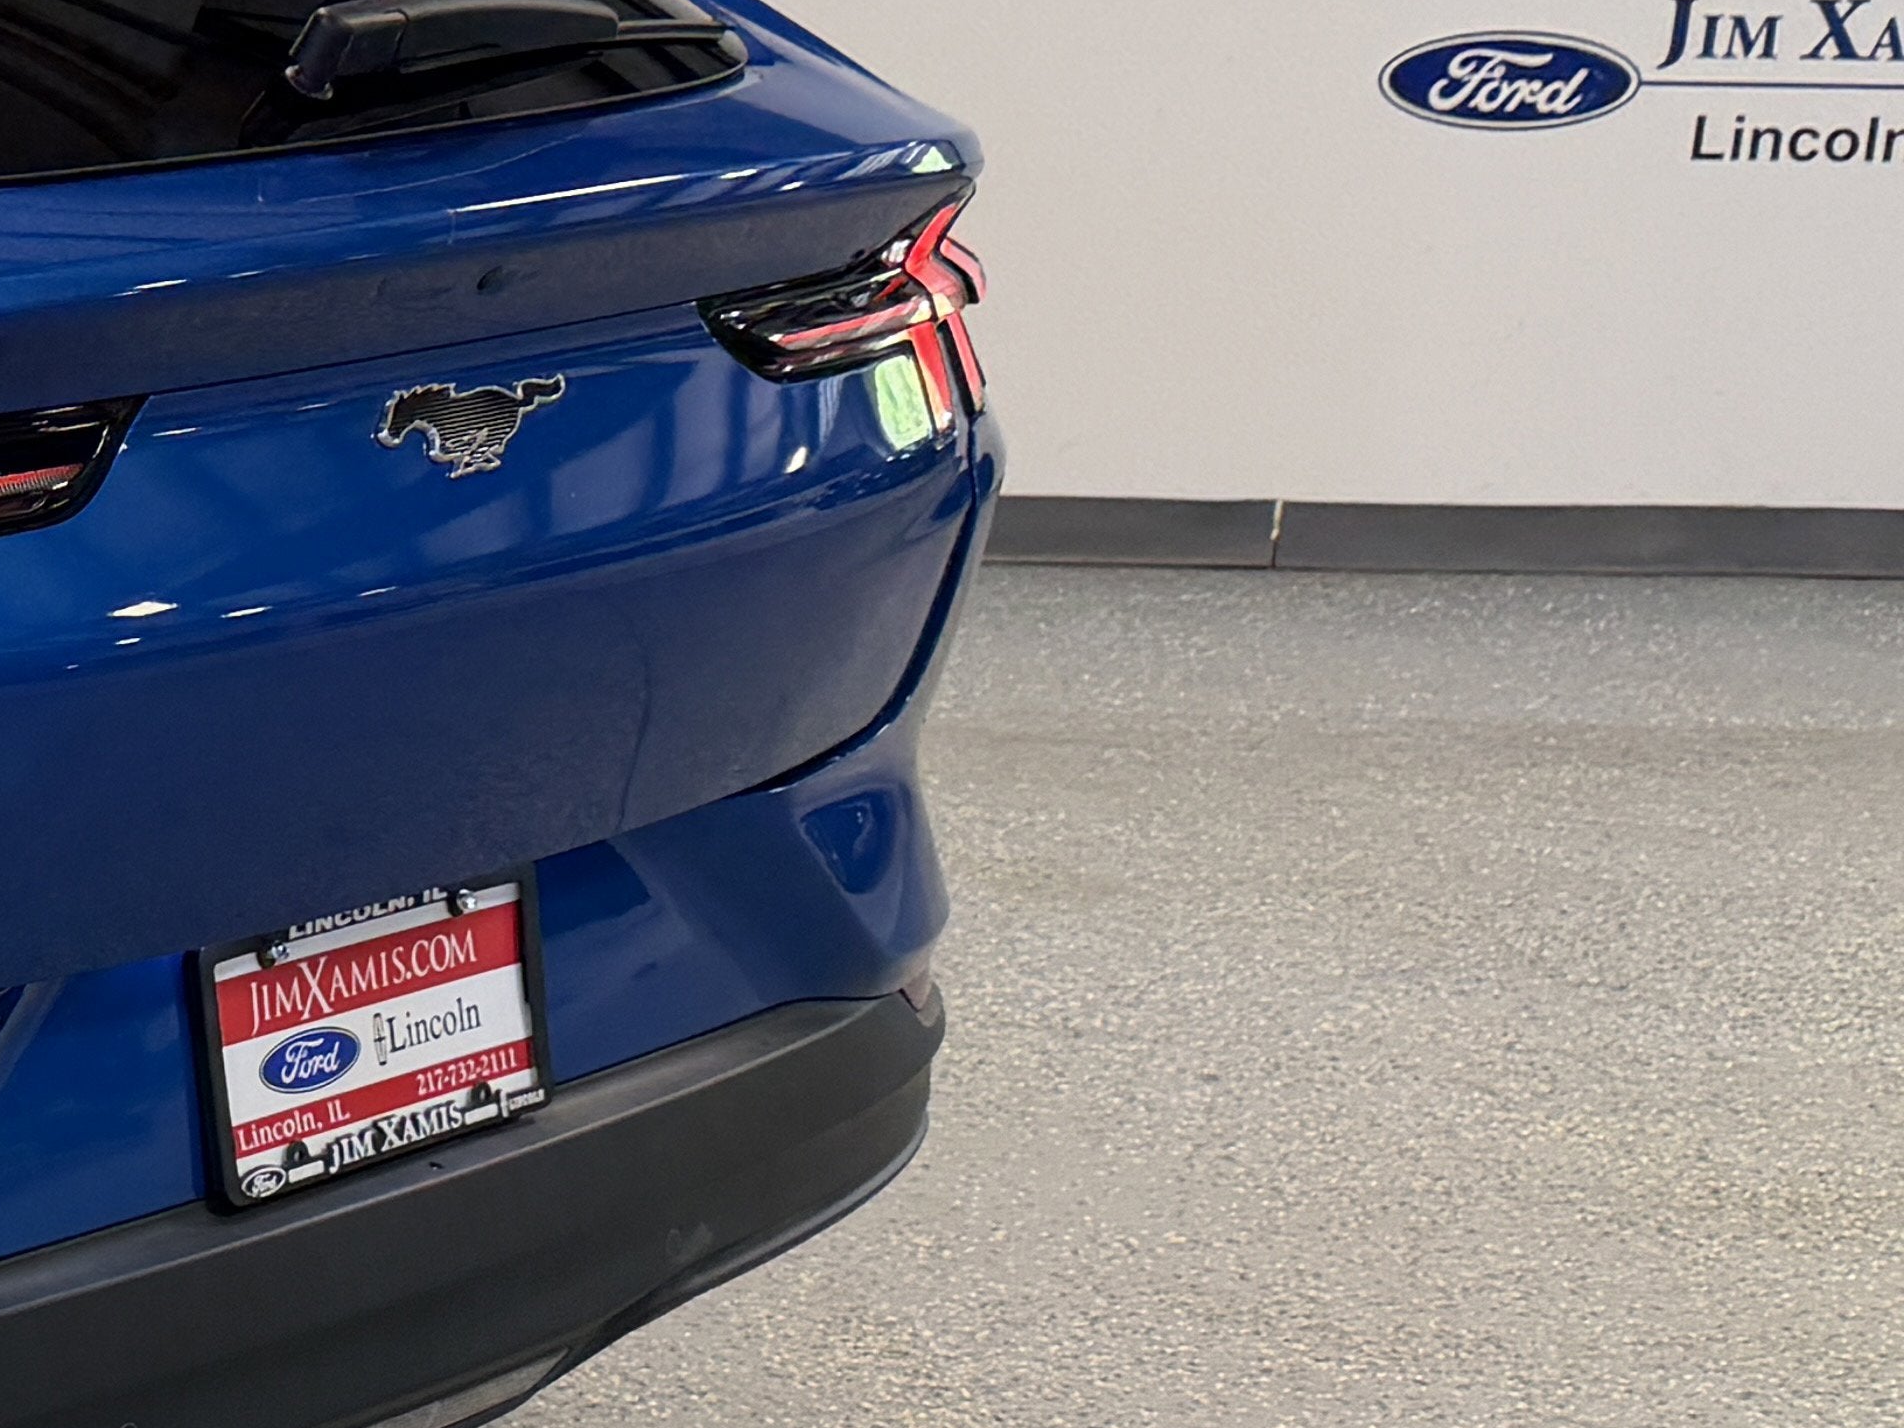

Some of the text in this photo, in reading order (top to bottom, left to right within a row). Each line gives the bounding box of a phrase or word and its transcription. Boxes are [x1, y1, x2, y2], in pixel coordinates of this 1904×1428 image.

[1427, 47, 1590, 114] Ford
[250, 928, 478, 1036] JIMXAMIS.COM
[386, 997, 483, 1054] Lincoln
[280, 1037, 341, 1085] Ford
[415, 1047, 518, 1096] 217-732-2111
[237, 1098, 351, 1152] Lincoln, IL
[328, 1102, 464, 1174] JIM XAMIS
